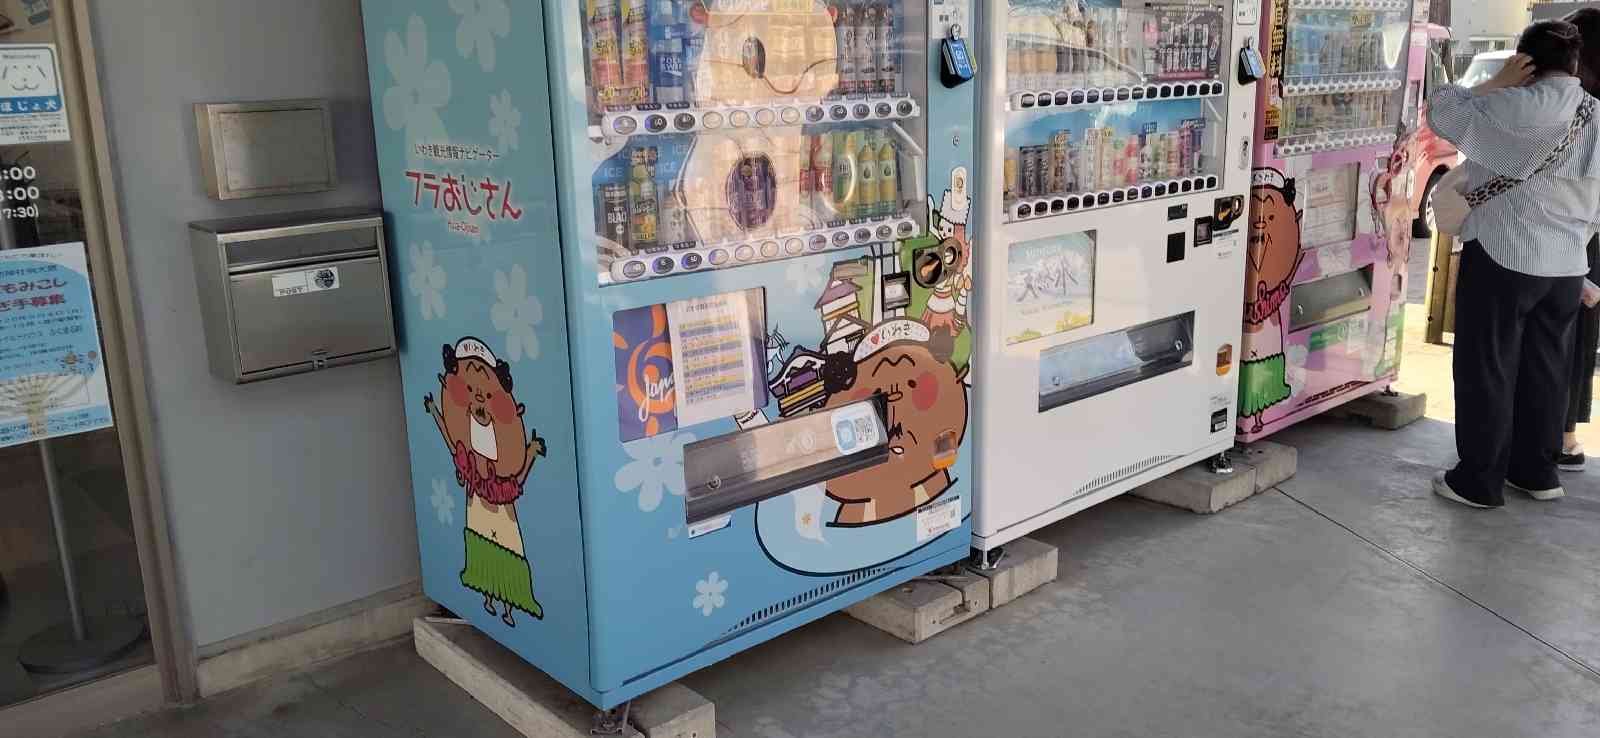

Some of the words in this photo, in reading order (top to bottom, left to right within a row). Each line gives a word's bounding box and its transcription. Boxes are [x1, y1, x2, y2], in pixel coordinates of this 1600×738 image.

[1, 100, 58, 112] ほじょ犬
[0, 166, 36, 180] :00
[405, 171, 523, 220] フラおじさん
[881, 323, 912, 340] いわき
